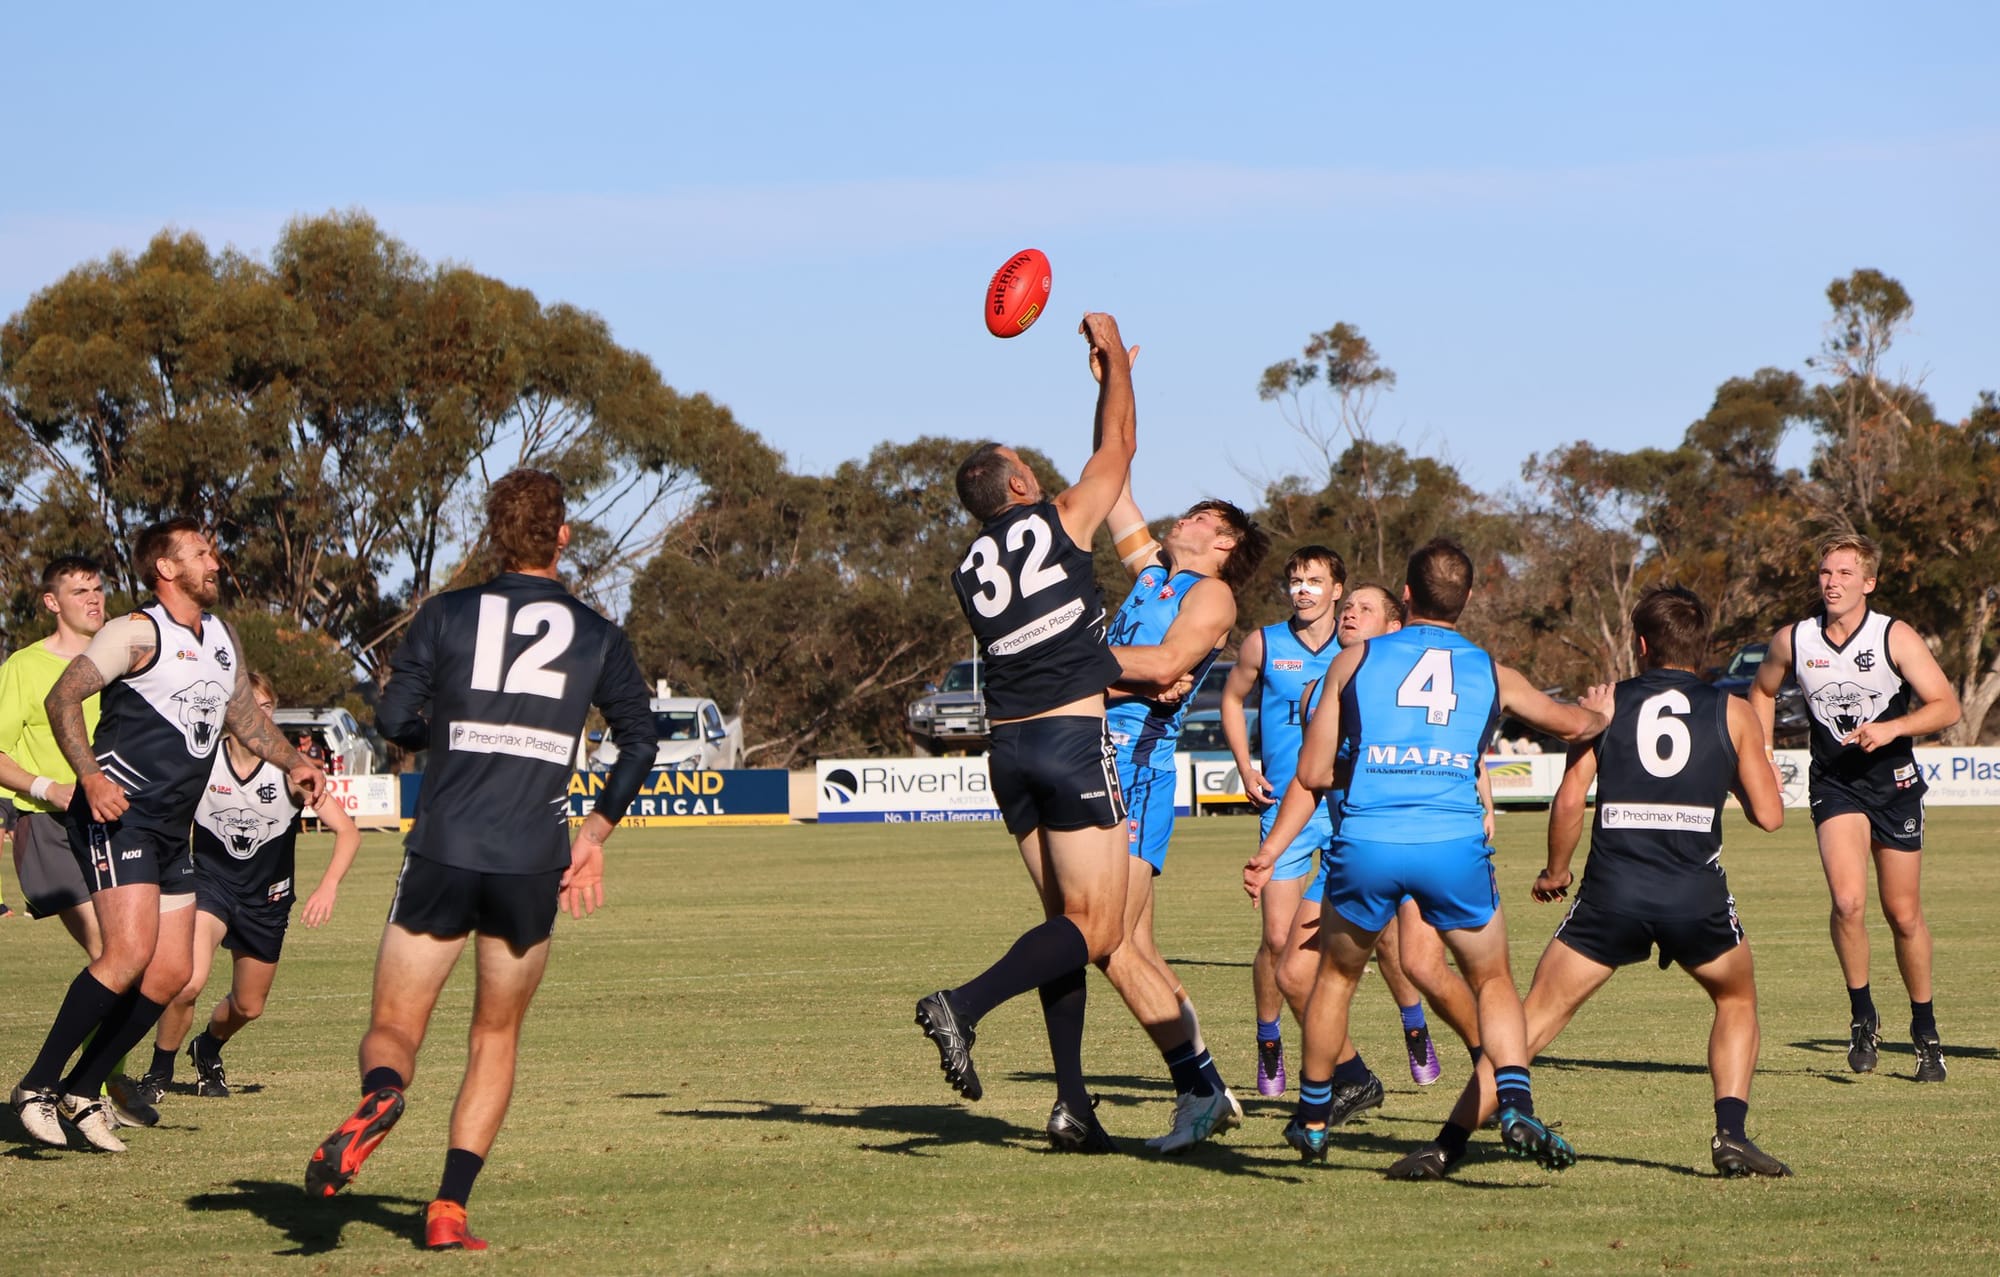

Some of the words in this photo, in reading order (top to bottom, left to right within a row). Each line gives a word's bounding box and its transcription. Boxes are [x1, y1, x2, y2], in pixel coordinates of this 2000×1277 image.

[993, 254, 1032, 315] SHERRIN
[960, 513, 1069, 618] 32
[1003, 625, 1048, 651] Precimax
[1048, 604, 1084, 629] Plastics
[471, 593, 575, 699] 12
[1396, 647, 1458, 726] 4
[468, 731, 523, 747] Precimax
[525, 736, 568, 755] Plastics
[1637, 688, 1691, 778] 6
[1367, 744, 1472, 769] MARS
[1917, 763, 1942, 780] ax
[1952, 757, 2000, 780] Plas
[327, 779, 353, 793] OT
[568, 771, 725, 796] ANLAND
[863, 766, 987, 793] Riverla
[1366, 768, 1418, 776] TRANSPORT
[1420, 768, 1469, 780] EQUIPMENT
[335, 795, 358, 810] NG
[566, 798, 725, 816] LETRICAL
[884, 812, 905, 823] No.
[910, 812, 914, 822] 1
[921, 811, 944, 822] East
[947, 810, 990, 822] Terrace
[1623, 810, 1673, 822] Precimax
[1676, 811, 1711, 825] Plastics
